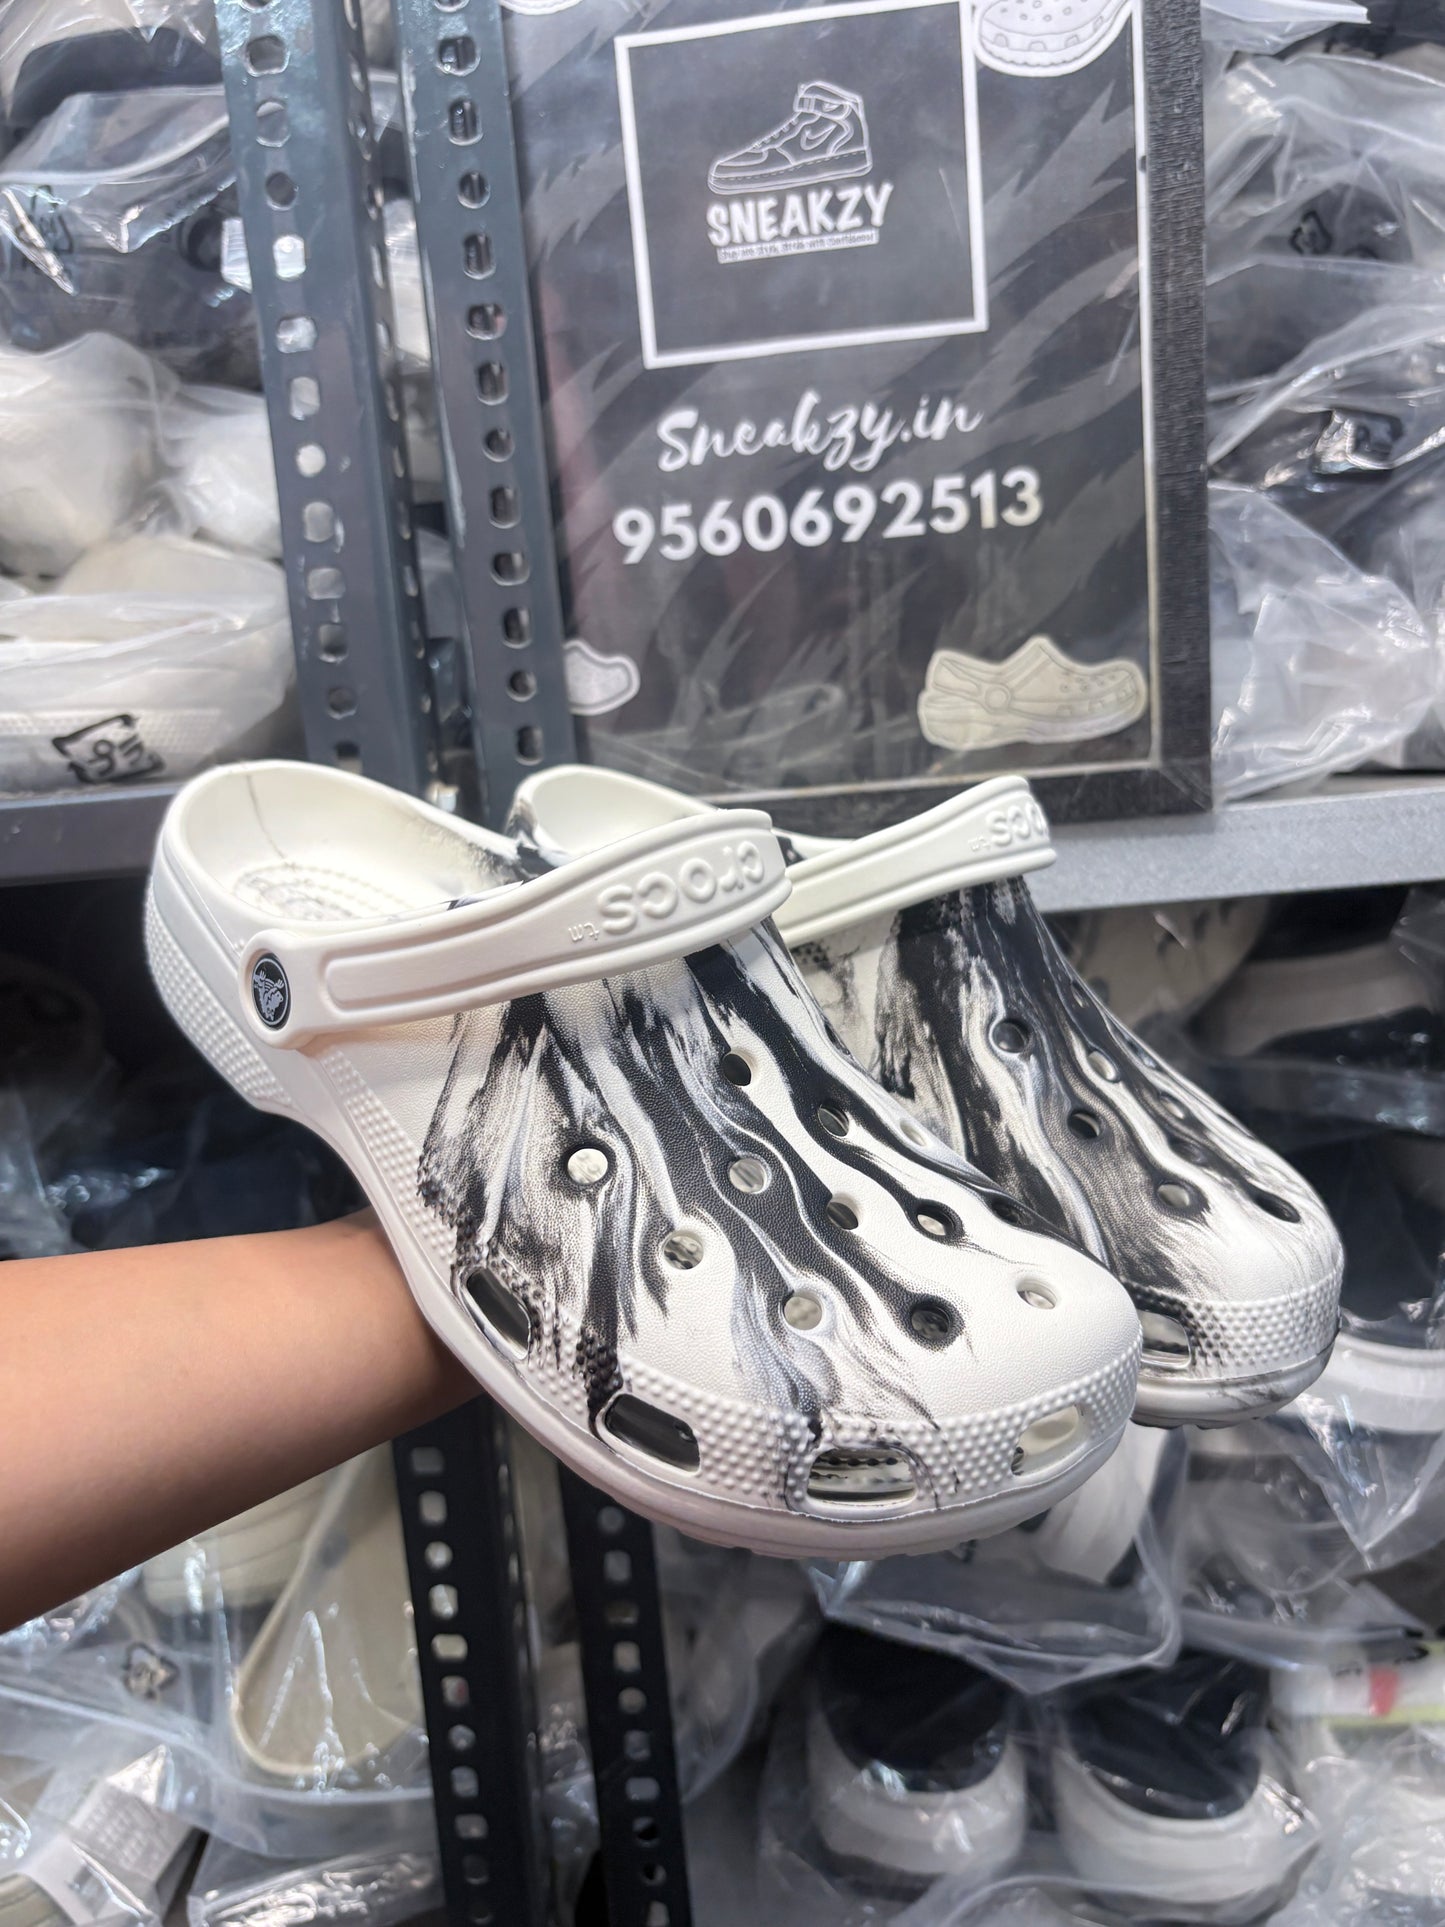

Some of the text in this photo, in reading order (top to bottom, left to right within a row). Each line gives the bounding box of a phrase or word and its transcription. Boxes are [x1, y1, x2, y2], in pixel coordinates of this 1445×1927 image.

[706, 181, 894, 247] SNEAKZY
[657, 390, 984, 472] Sneakzy.in
[612, 466, 1043, 565] 9560692513
[597, 840, 765, 935] crocs
